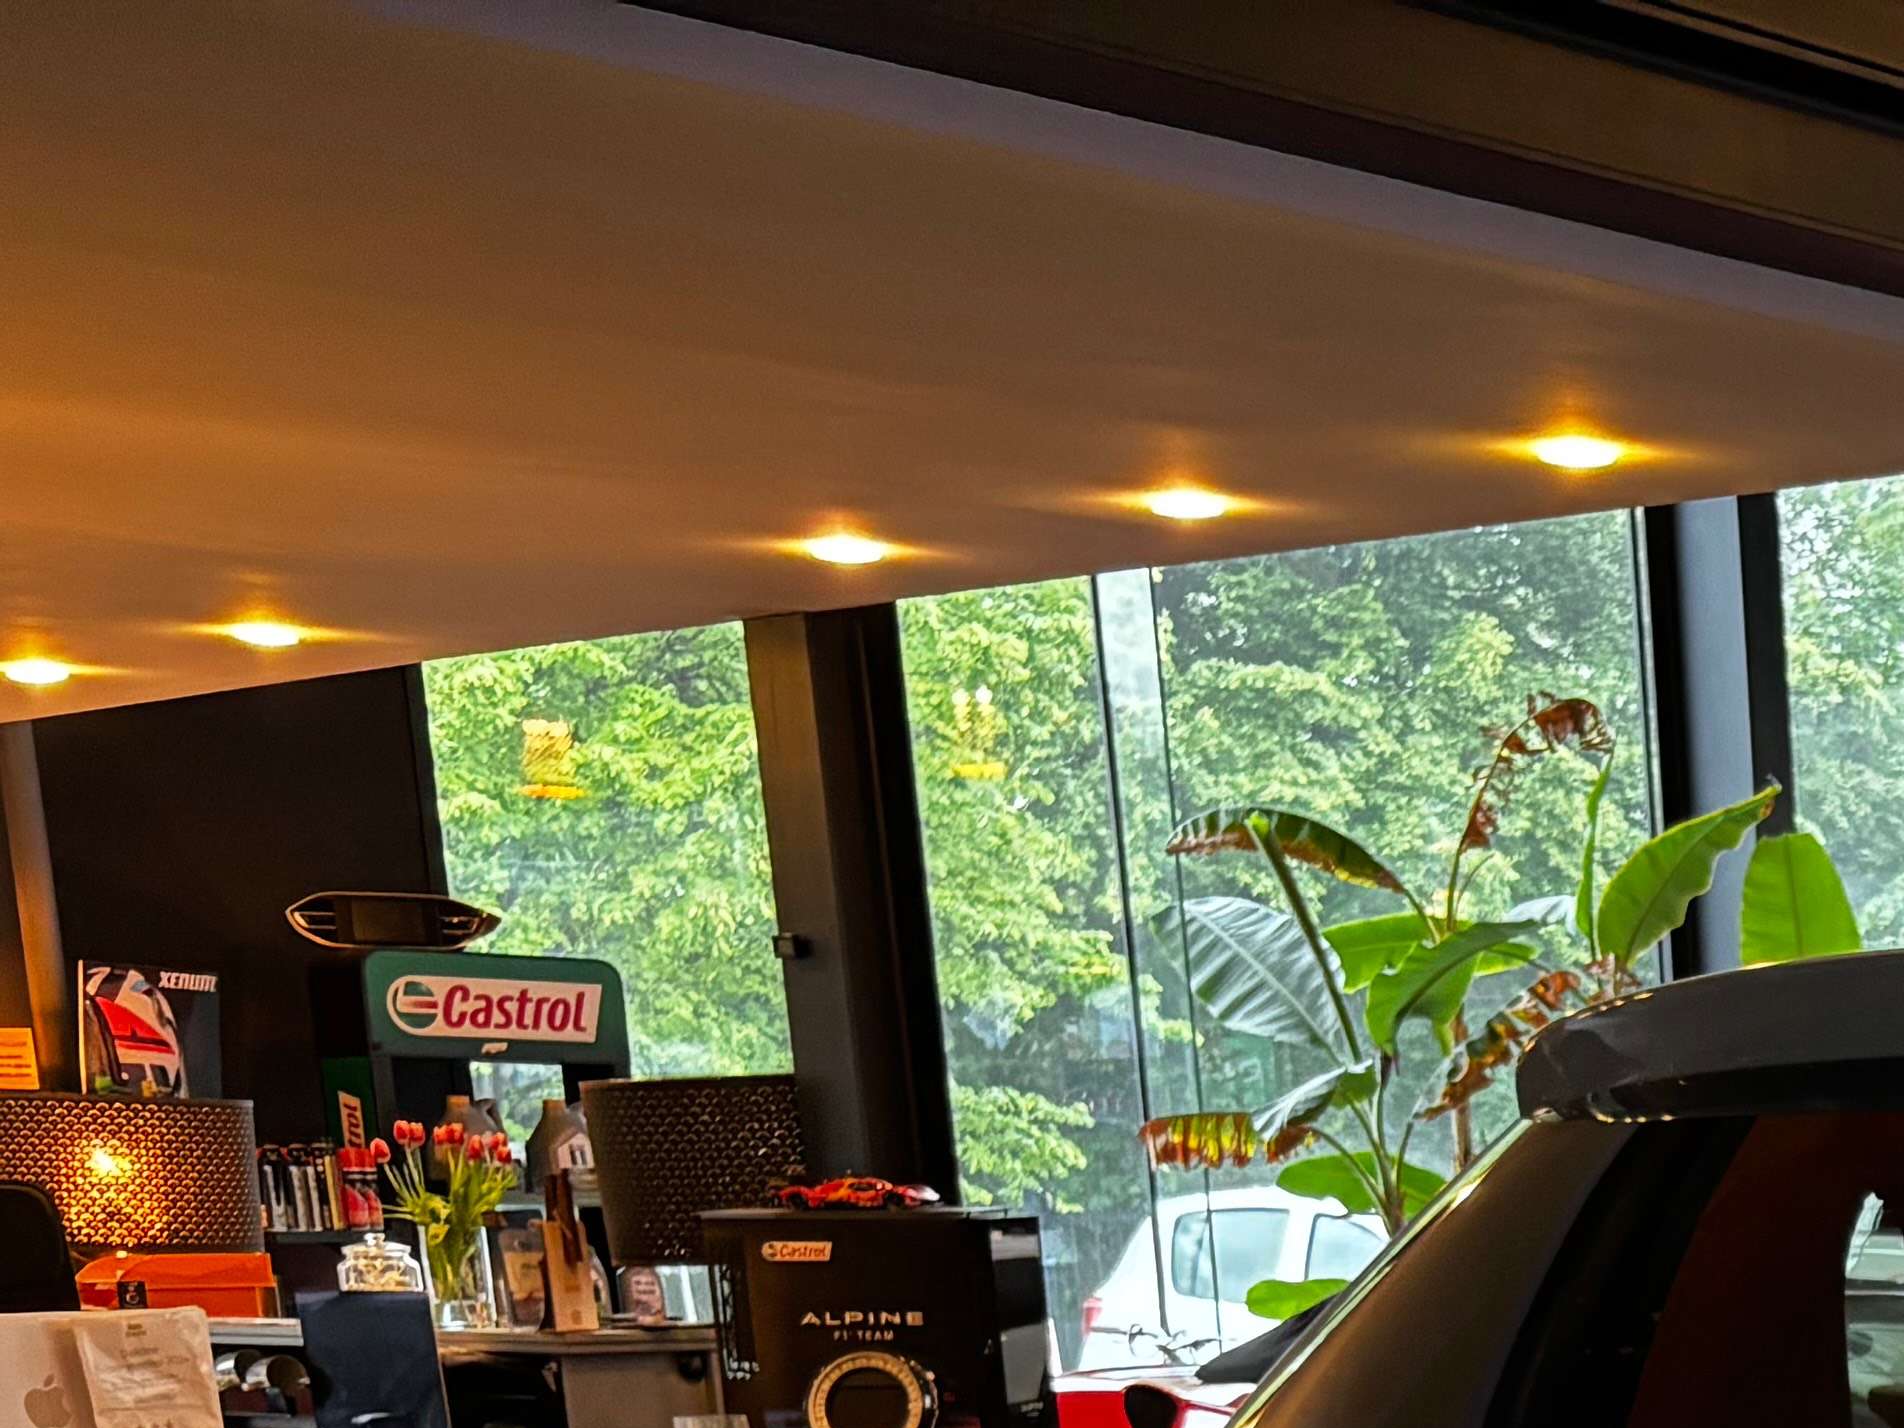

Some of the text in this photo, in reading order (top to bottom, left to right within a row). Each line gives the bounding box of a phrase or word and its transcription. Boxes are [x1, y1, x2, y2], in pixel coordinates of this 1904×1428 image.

[443, 984, 586, 1032] Castrol
[779, 1244, 826, 1258] Castrol
[801, 1311, 924, 1326] ALPINE
[857, 1330, 894, 1341] TEAM
